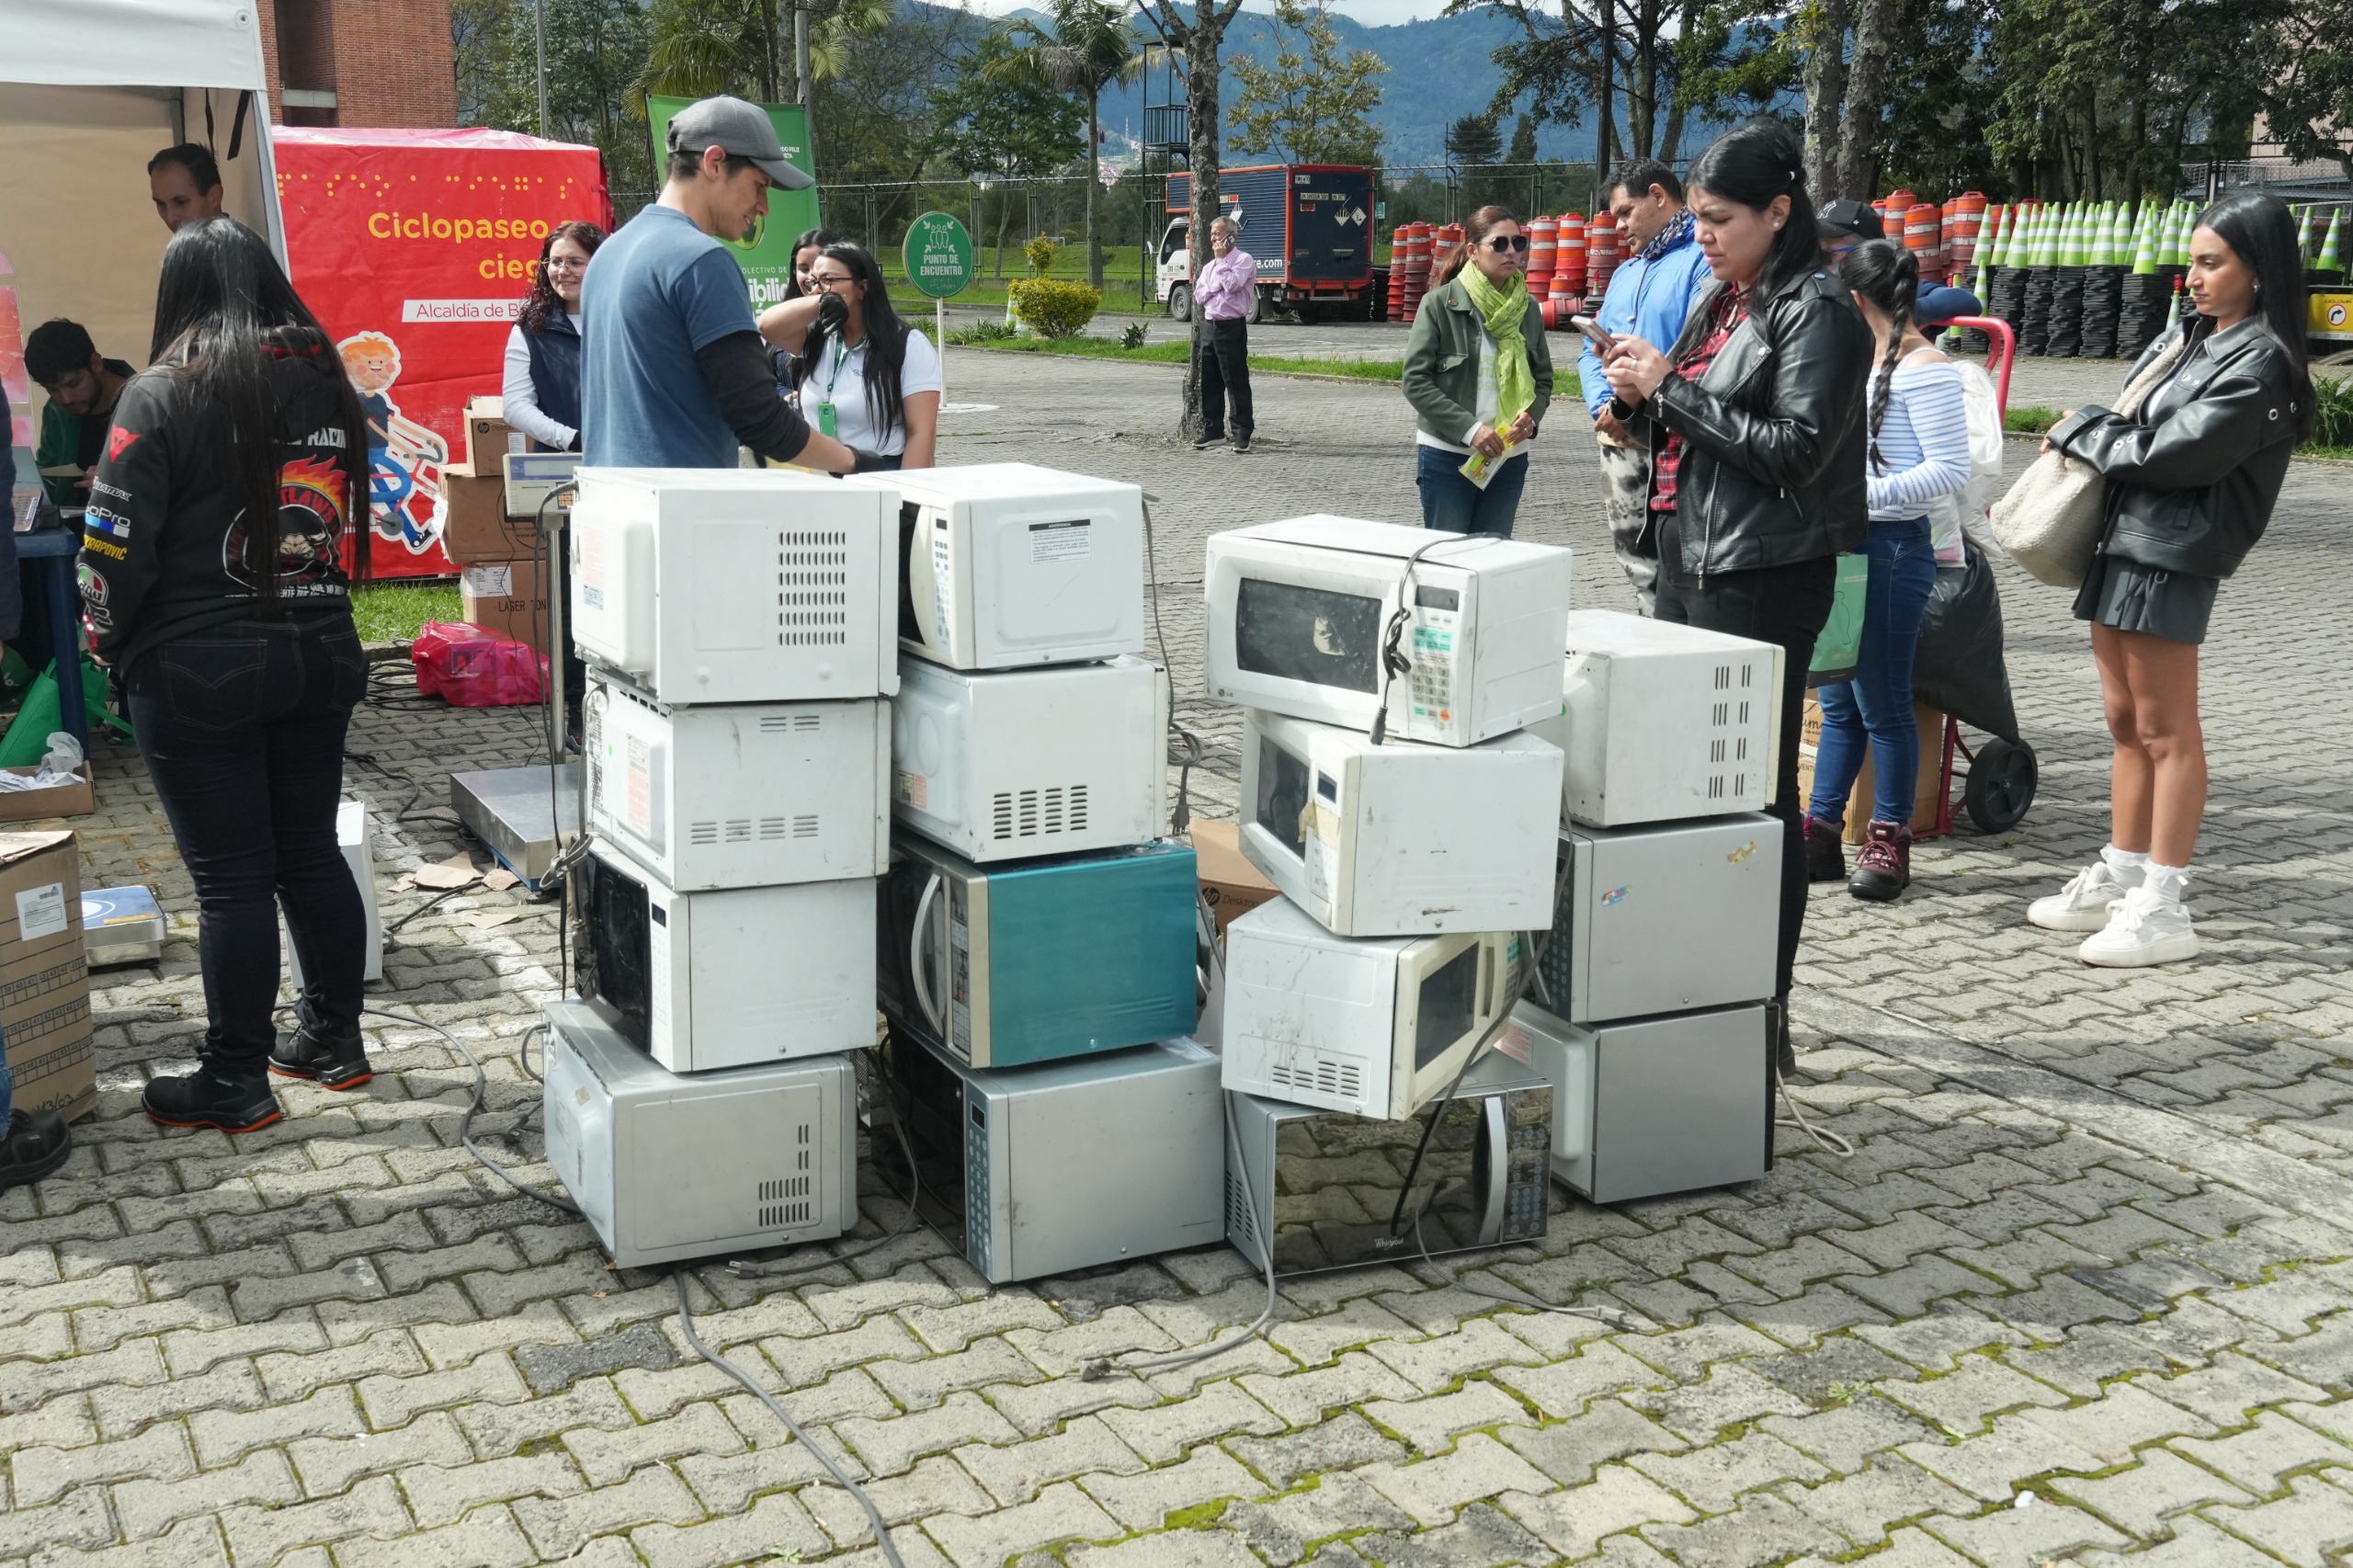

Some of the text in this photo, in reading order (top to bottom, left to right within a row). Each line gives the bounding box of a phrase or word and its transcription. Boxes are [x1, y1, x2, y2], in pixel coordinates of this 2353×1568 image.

[368, 211, 549, 244] Ciclopaseo
[924, 255, 959, 264] PUNTO DE
[479, 254, 536, 283] cieg
[920, 266, 962, 276] ENCUENTRO
[748, 278, 789, 302] ibilid
[416, 303, 480, 318] Alcaldía
[484, 303, 504, 317] de
[477, 422, 490, 434] hp
[93, 480, 133, 502] BATTLAX
[498, 600, 526, 612] LASER
[1223, 894, 1259, 909] Desktop
[1374, 1236, 1404, 1250] Whirlpool
